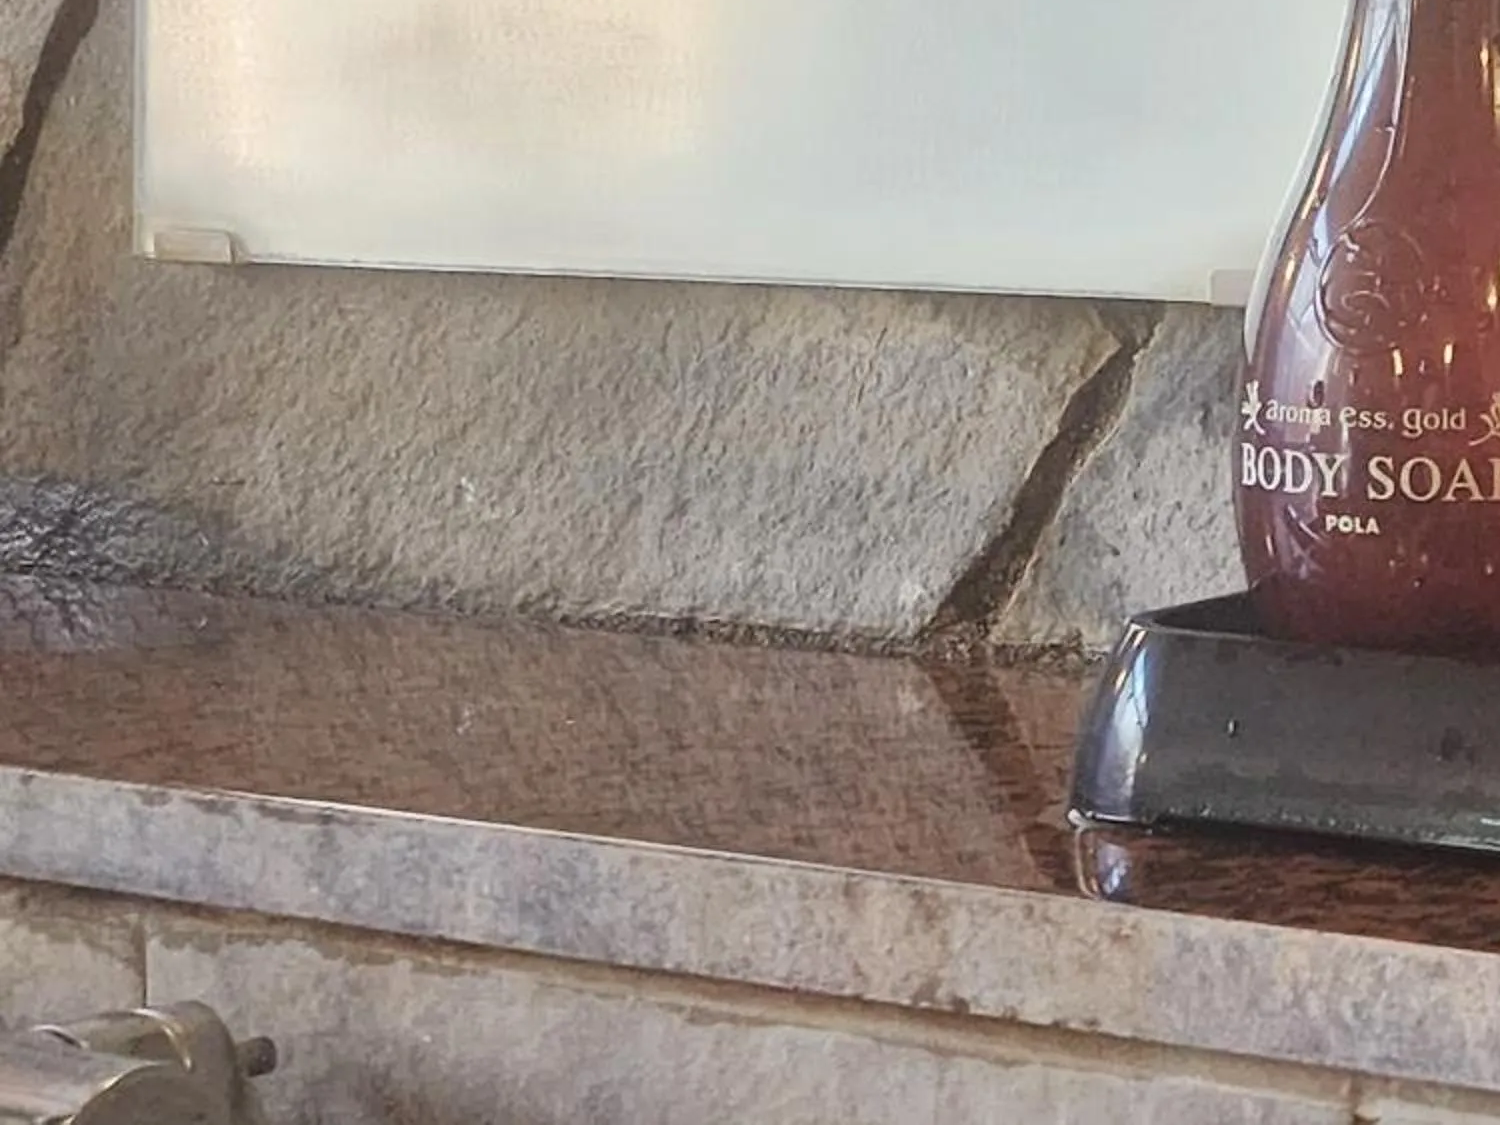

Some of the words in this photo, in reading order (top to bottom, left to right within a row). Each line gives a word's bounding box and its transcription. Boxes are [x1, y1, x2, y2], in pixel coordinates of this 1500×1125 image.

[1265, 398, 1331, 426] aroma
[1339, 406, 1395, 430] ess.
[1402, 408, 1467, 438] gold
[1241, 442, 1348, 498] BODY
[1325, 514, 1381, 536] POLA
